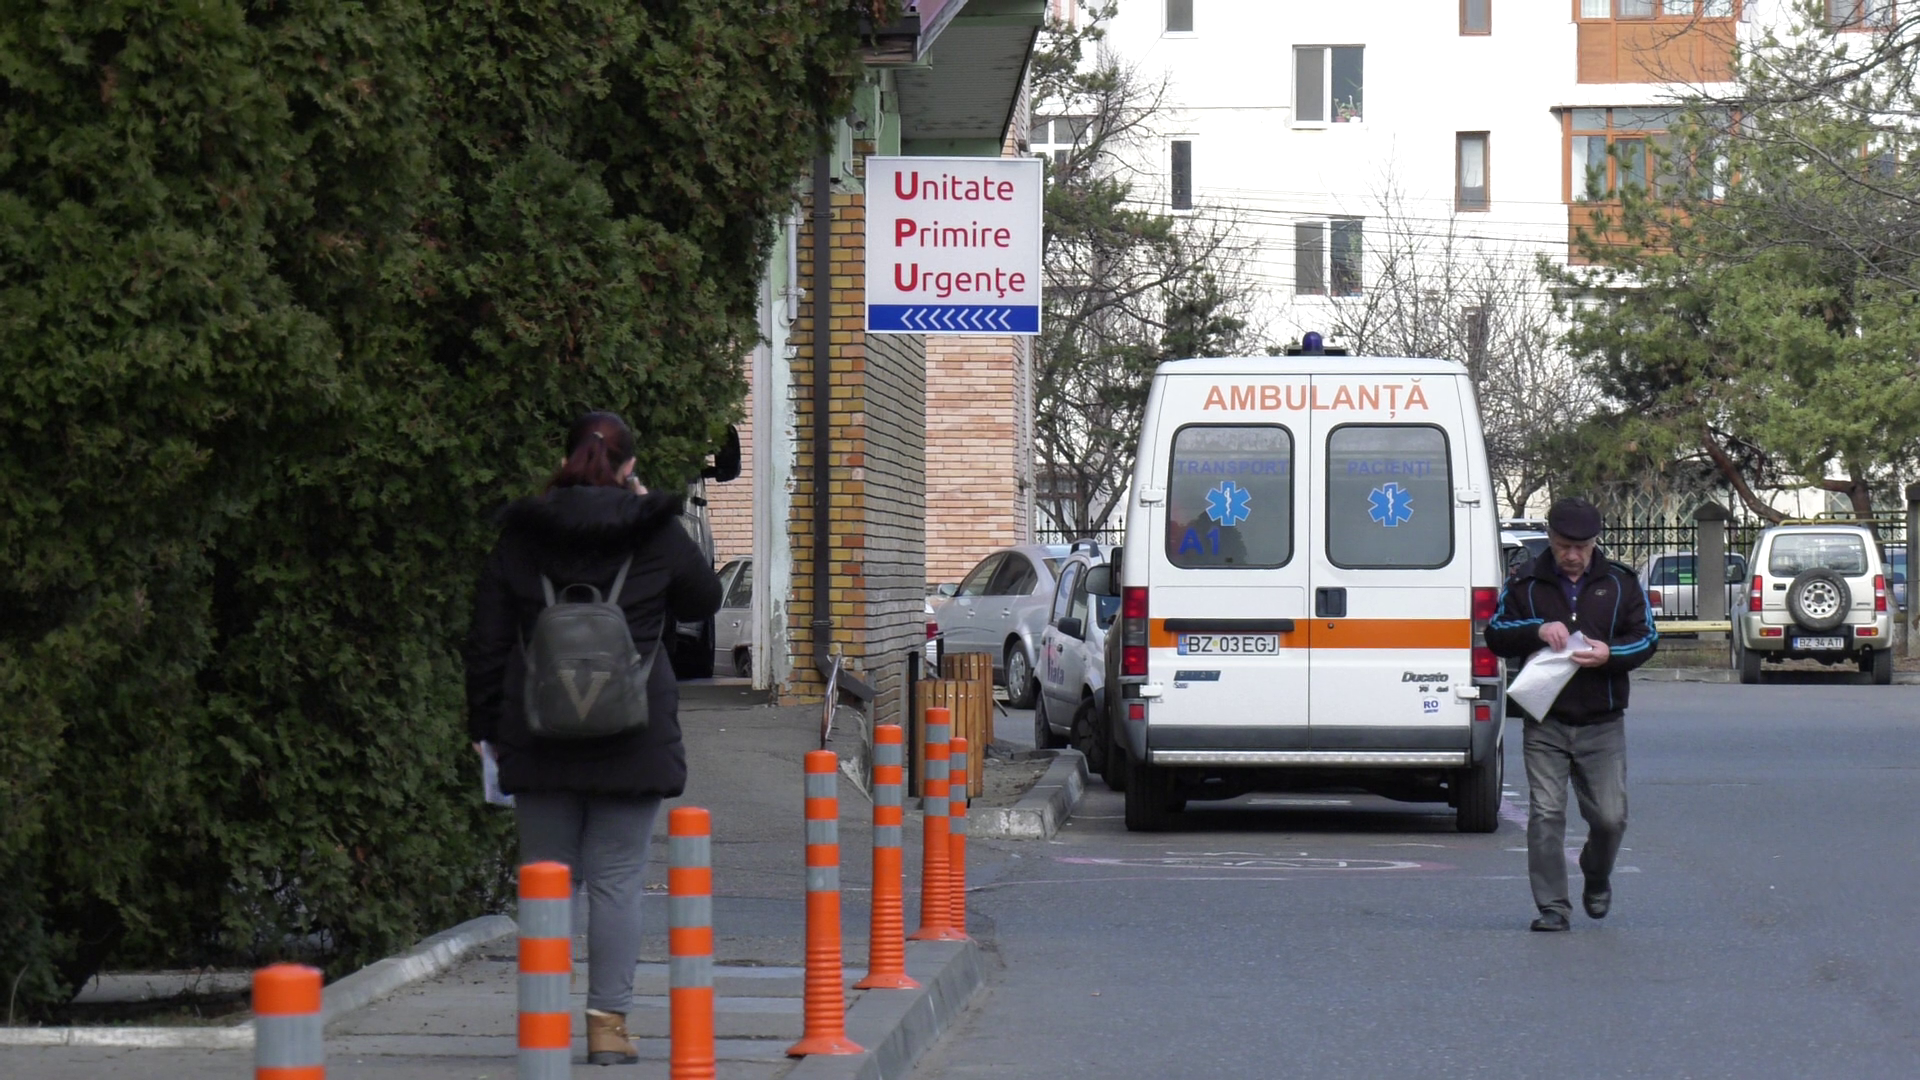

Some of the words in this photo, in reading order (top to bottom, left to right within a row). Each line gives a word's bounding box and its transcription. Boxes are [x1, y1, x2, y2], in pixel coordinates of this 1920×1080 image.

[894, 171, 1014, 201] Unitate
[895, 218, 1011, 248] Primire
[1177, 460, 1288, 474] TRANSPORT
[1178, 527, 1220, 556] A1
[1188, 636, 1213, 653] BZ
[1220, 636, 1240, 653] 03
[1242, 636, 1276, 653] EGJ
[1800, 638, 1812, 647] BZ
[1815, 638, 1825, 647] 34
[1179, 670, 1219, 679] FIAT
[1401, 671, 1449, 683] Ducato
[1423, 700, 1439, 709] RO
